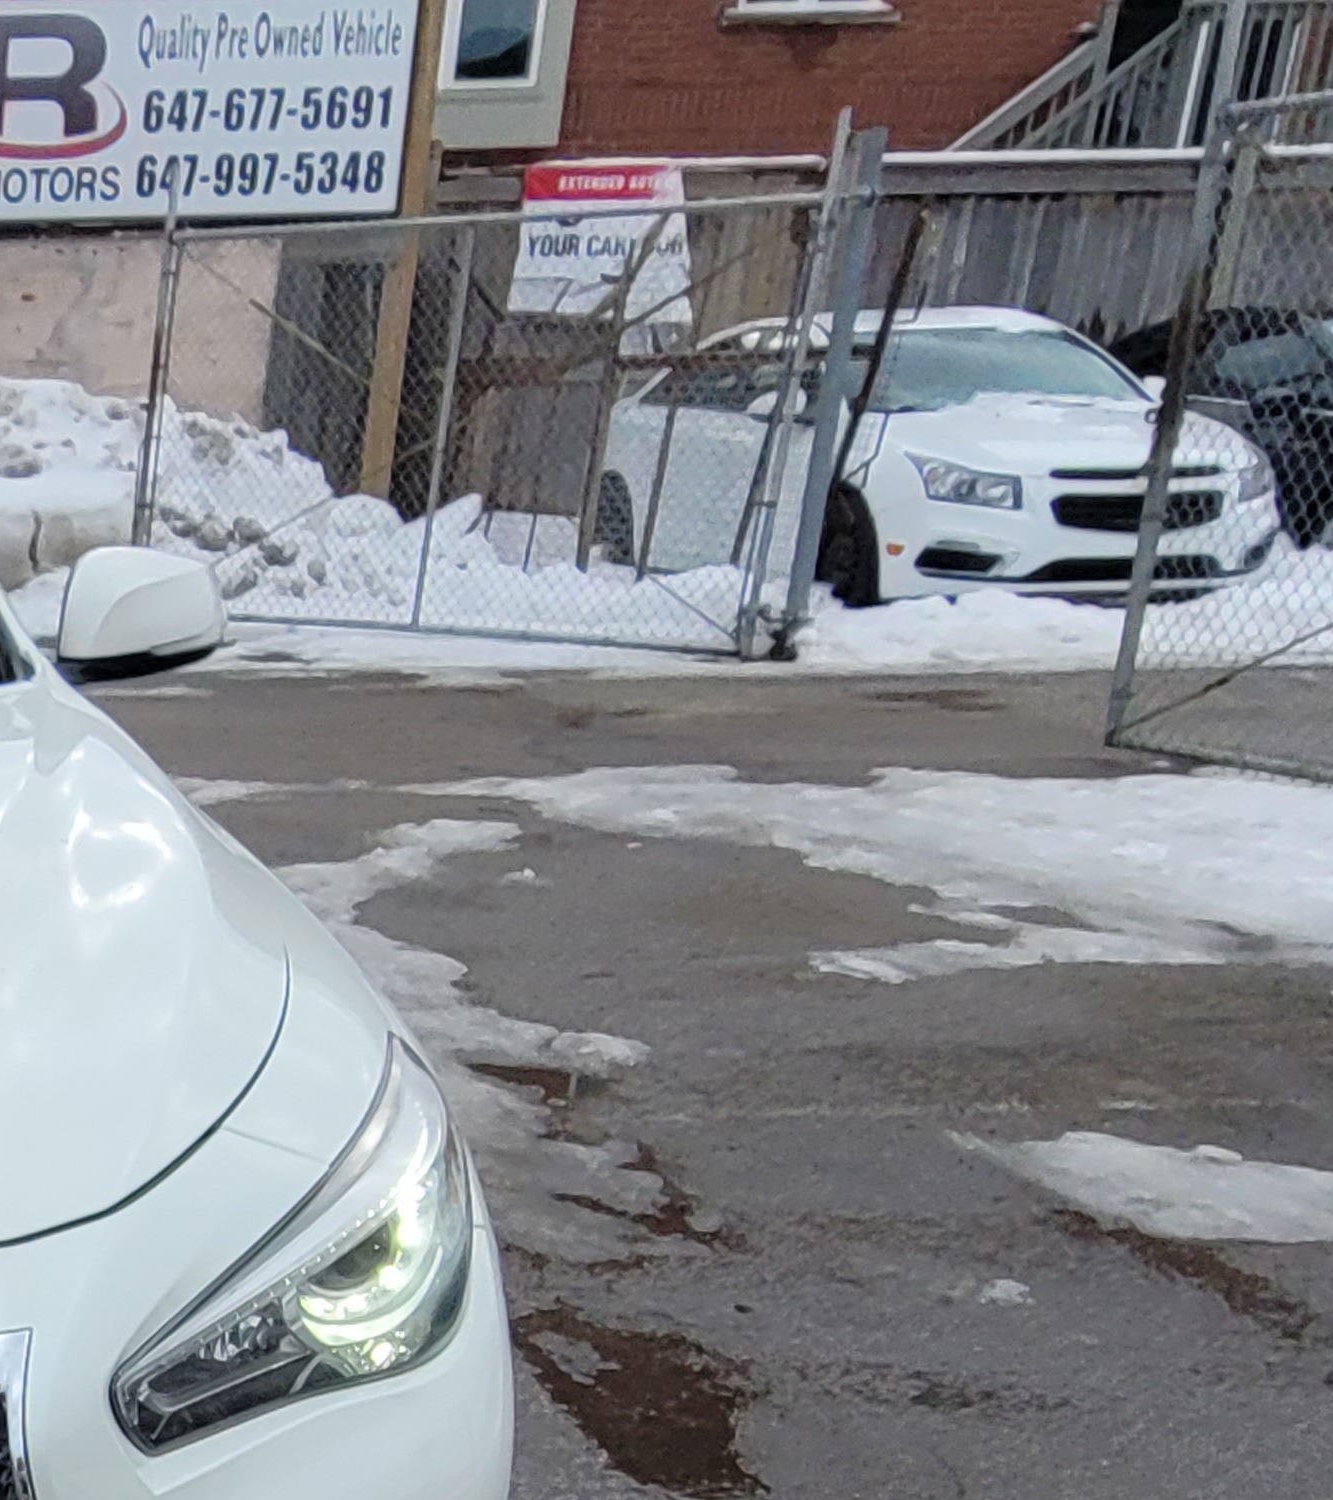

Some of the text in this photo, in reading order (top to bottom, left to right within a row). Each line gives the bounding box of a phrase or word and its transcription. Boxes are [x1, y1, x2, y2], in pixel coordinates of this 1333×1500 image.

[138, 9, 402, 74] Quality Pre Owned Vehicle
[142, 85, 393, 134] 647-677-5691
[136, 150, 386, 198] 647-997-5348
[528, 233, 581, 258] YOUR
